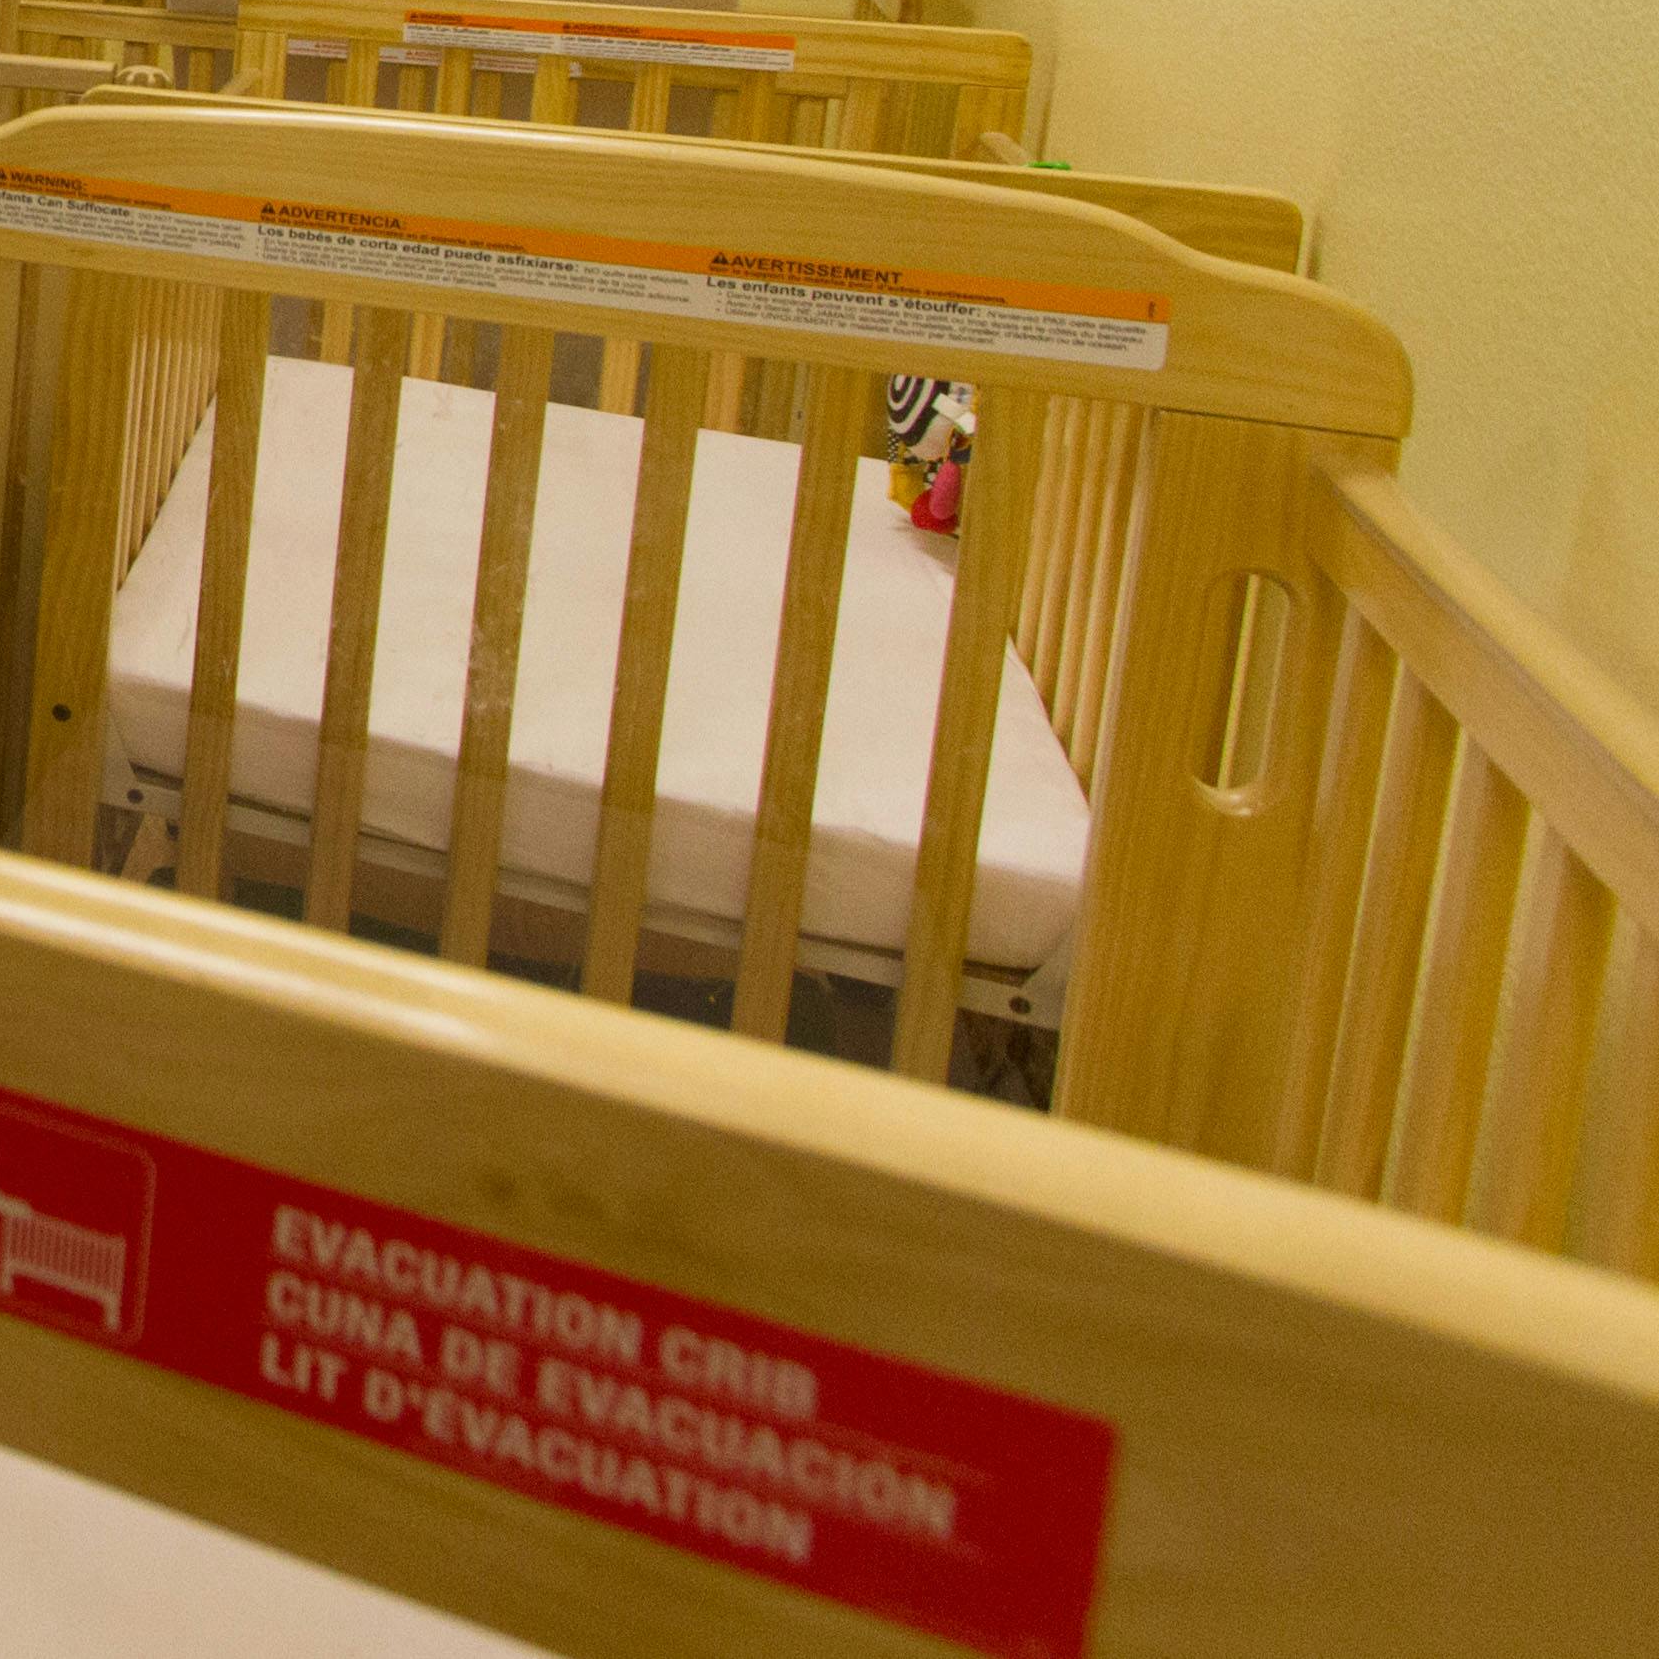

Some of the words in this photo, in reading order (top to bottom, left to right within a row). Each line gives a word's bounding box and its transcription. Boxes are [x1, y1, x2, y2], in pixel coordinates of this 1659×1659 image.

[10, 171, 88, 191] WARNING:
[37, 195, 62, 208] Can
[257, 224, 283, 236] Los
[337, 234, 354, 245] de
[359, 237, 397, 250] corta
[402, 242, 439, 255] edad
[443, 247, 491, 264] puede
[729, 255, 903, 284] AVERTISSEMENT
[706, 276, 735, 289] Les
[742, 280, 805, 297] enfants
[811, 288, 883, 306] peuvent
[272, 1204, 645, 1365] EVACUATION
[659, 1325, 819, 1422] CRIB
[265, 1271, 423, 1363] CUNA
[441, 1325, 521, 1398] DE
[259, 1332, 347, 1402] LIT
